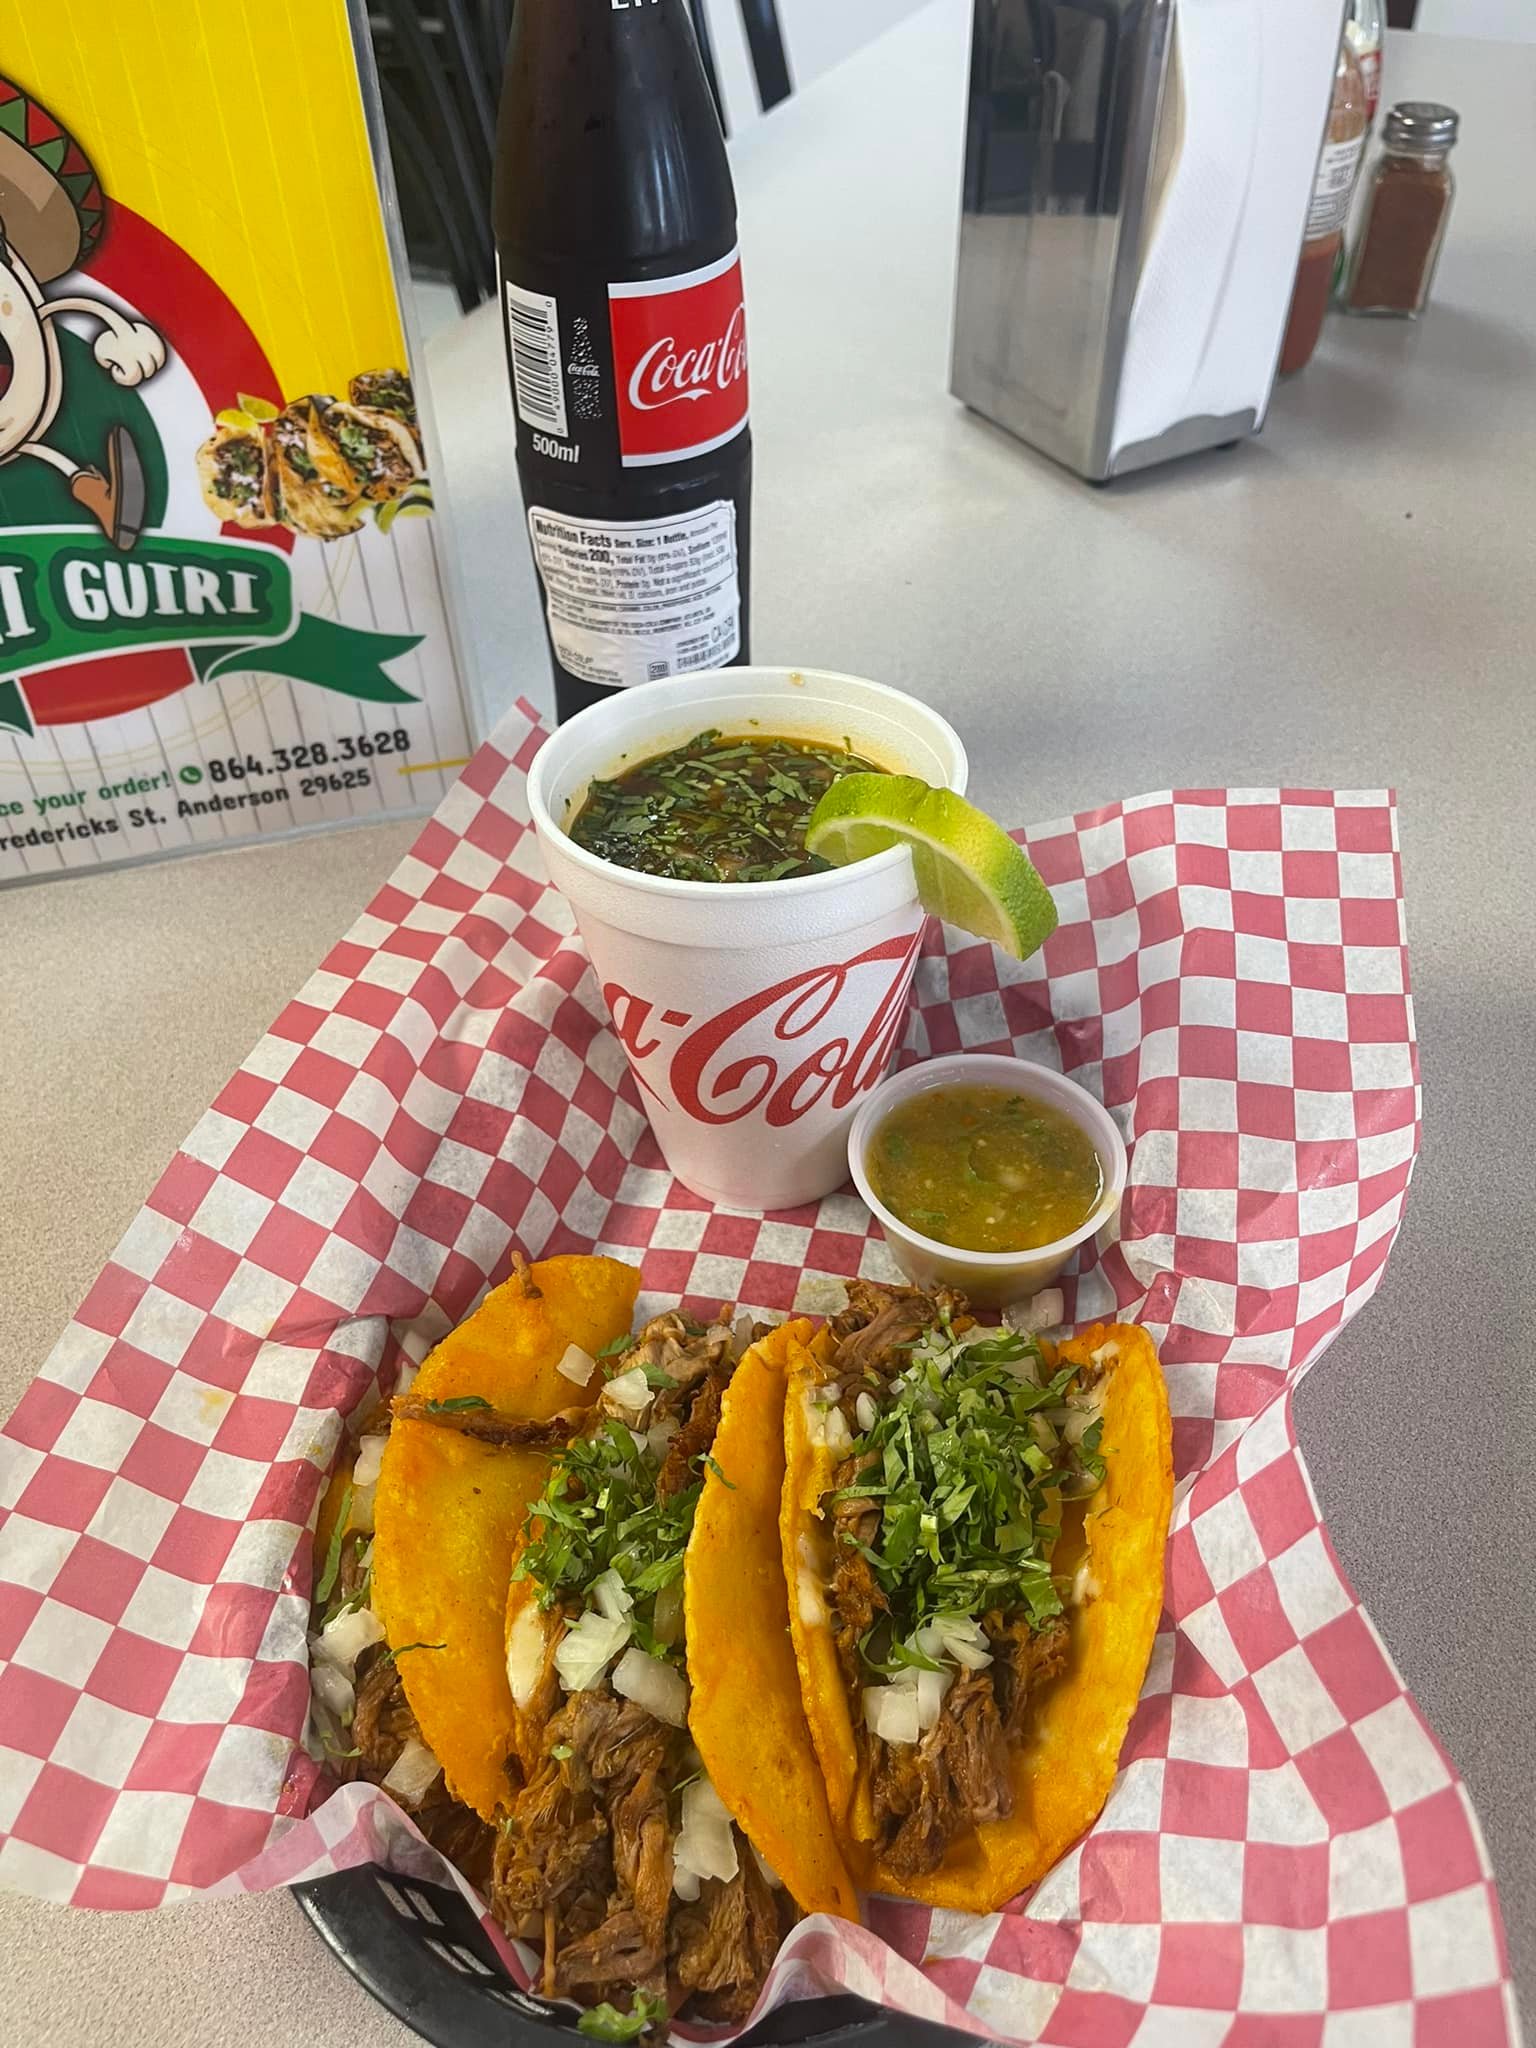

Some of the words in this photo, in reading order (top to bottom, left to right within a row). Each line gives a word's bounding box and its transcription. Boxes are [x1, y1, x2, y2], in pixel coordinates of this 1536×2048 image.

[532, 432, 580, 463] 500ml
[536, 519, 579, 543] Nutrition
[580, 531, 612, 548] Facts
[63, 560, 259, 621] GUIRI
[33, 791, 87, 816] your
[98, 770, 172, 801] order!
[207, 729, 411, 783] 864.328.3628
[0, 817, 119, 851] redericks
[128, 806, 167, 828] St.
[177, 786, 290, 818] Anderson
[300, 768, 372, 797] 29625
